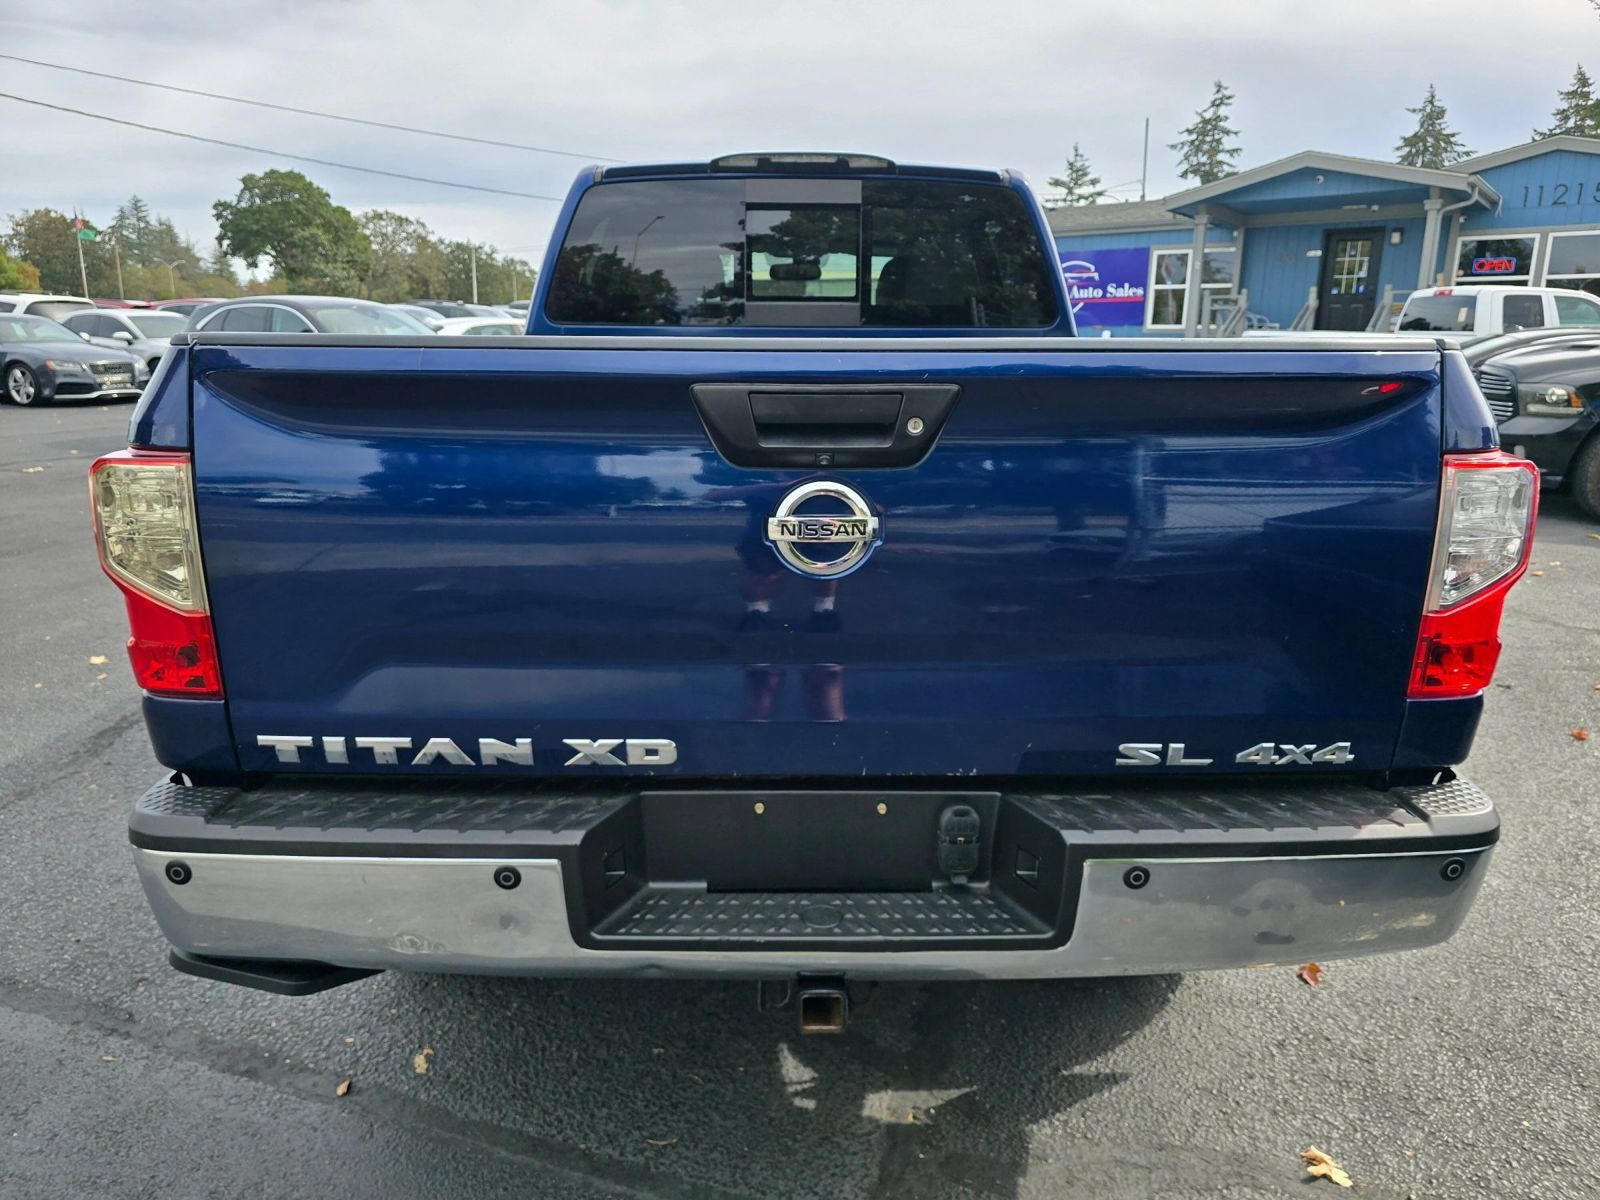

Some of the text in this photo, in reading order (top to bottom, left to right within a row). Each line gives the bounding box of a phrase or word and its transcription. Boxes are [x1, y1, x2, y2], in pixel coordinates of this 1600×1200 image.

[1475, 259, 1514, 272] OPEN
[1070, 283, 1144, 299] Auto Sales
[780, 523, 866, 537] NISSAN
[256, 735, 678, 766] TITAN XD
[1115, 743, 1214, 766] SL
